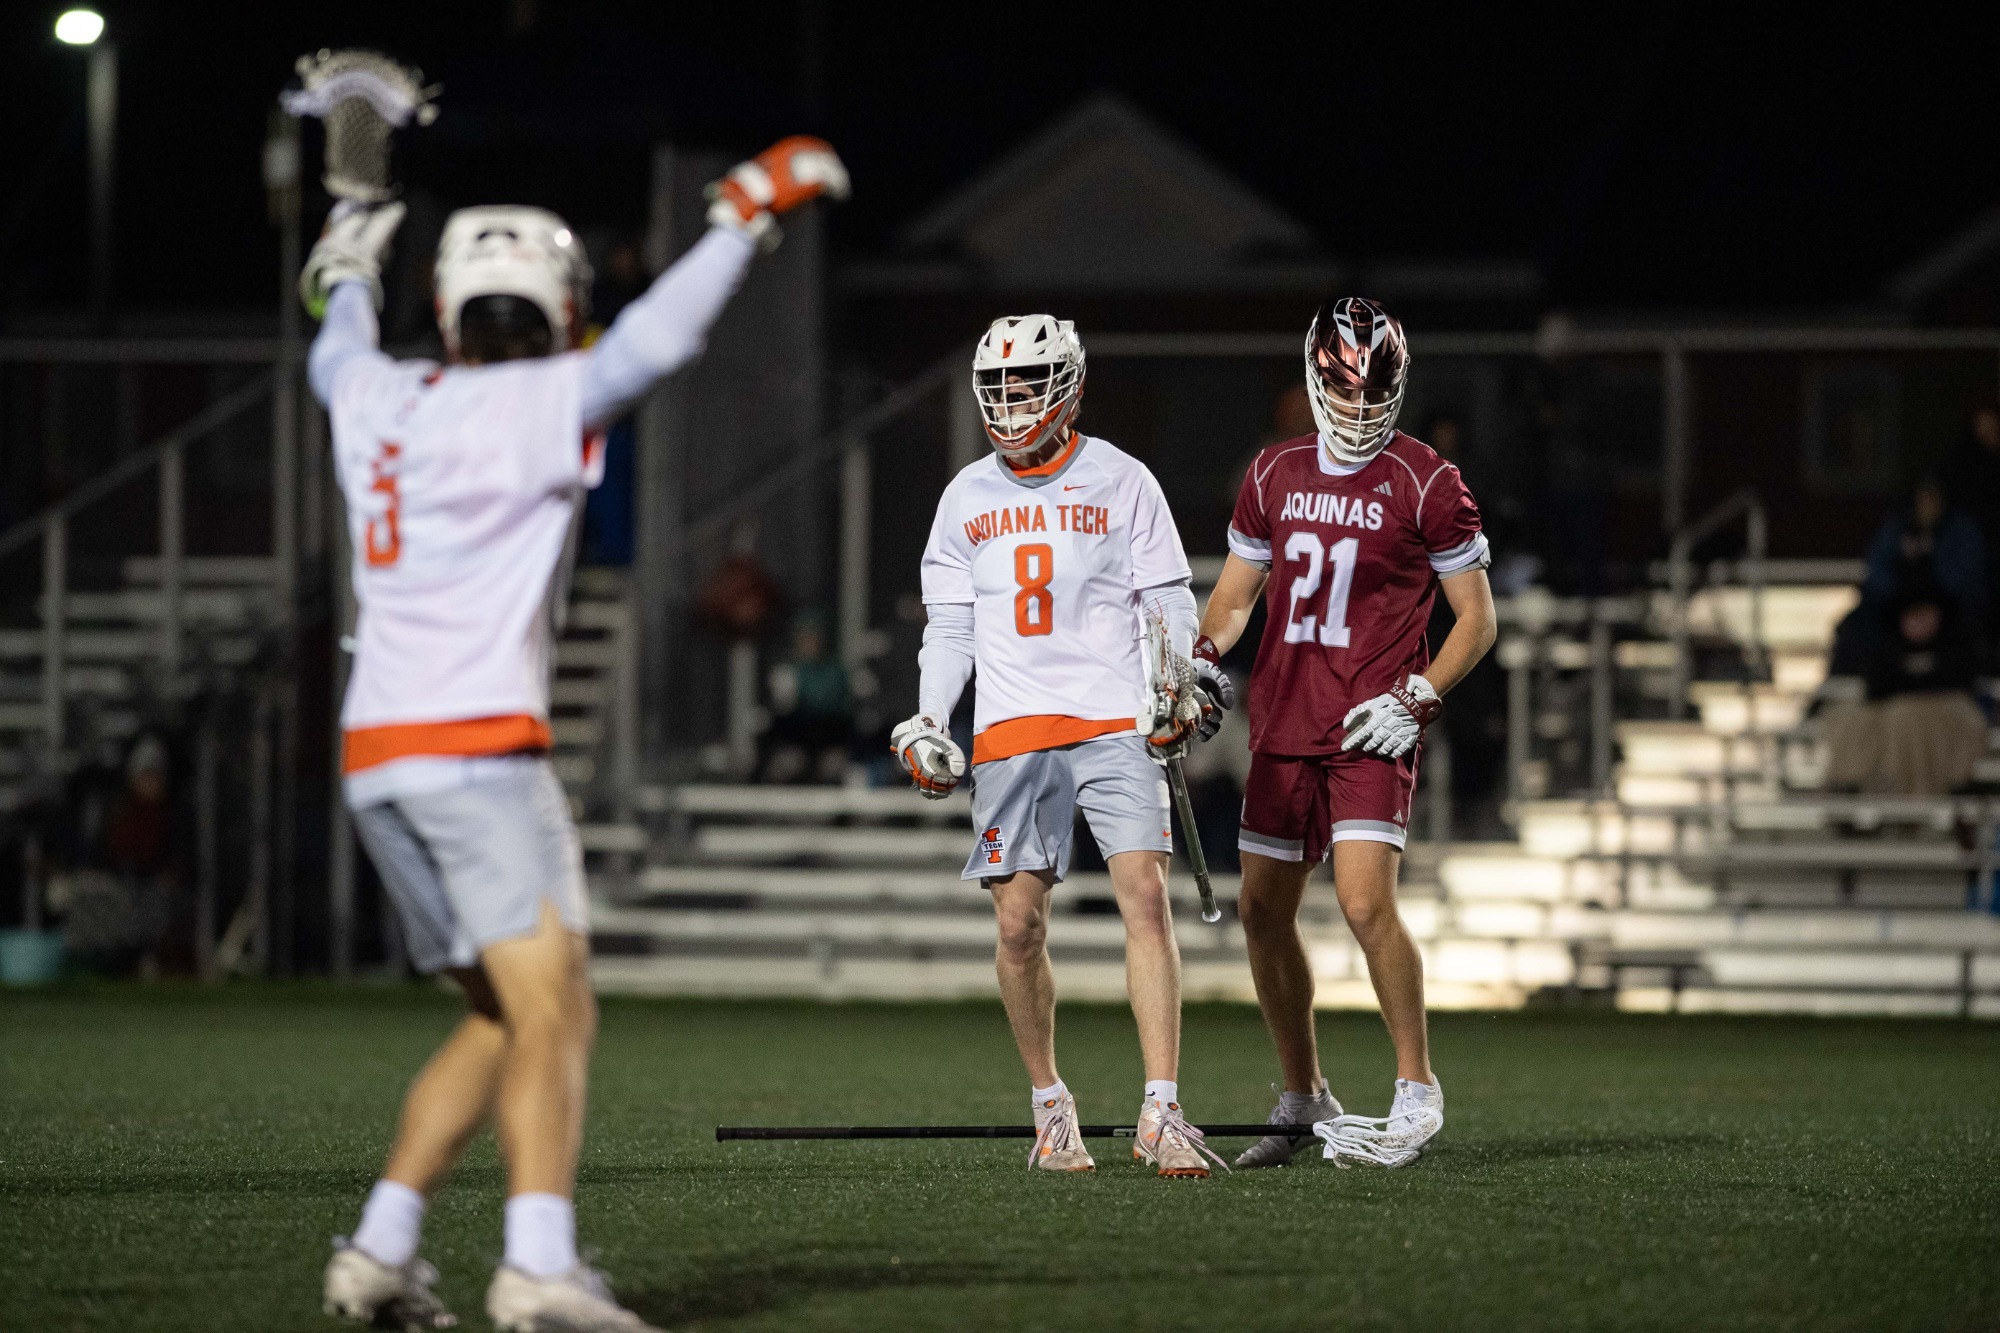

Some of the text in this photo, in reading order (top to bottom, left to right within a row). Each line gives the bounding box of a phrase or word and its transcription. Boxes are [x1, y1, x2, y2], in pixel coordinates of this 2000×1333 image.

[963, 503, 1109, 547] INDIANA TECH
[1281, 491, 1384, 531] AQUINAS
[1014, 542, 1053, 637] 8
[1284, 531, 1359, 648] 21
[1390, 685, 1423, 717] SAINTS
[983, 842, 1003, 850] TECH
[1113, 1128, 1138, 1137] ST
